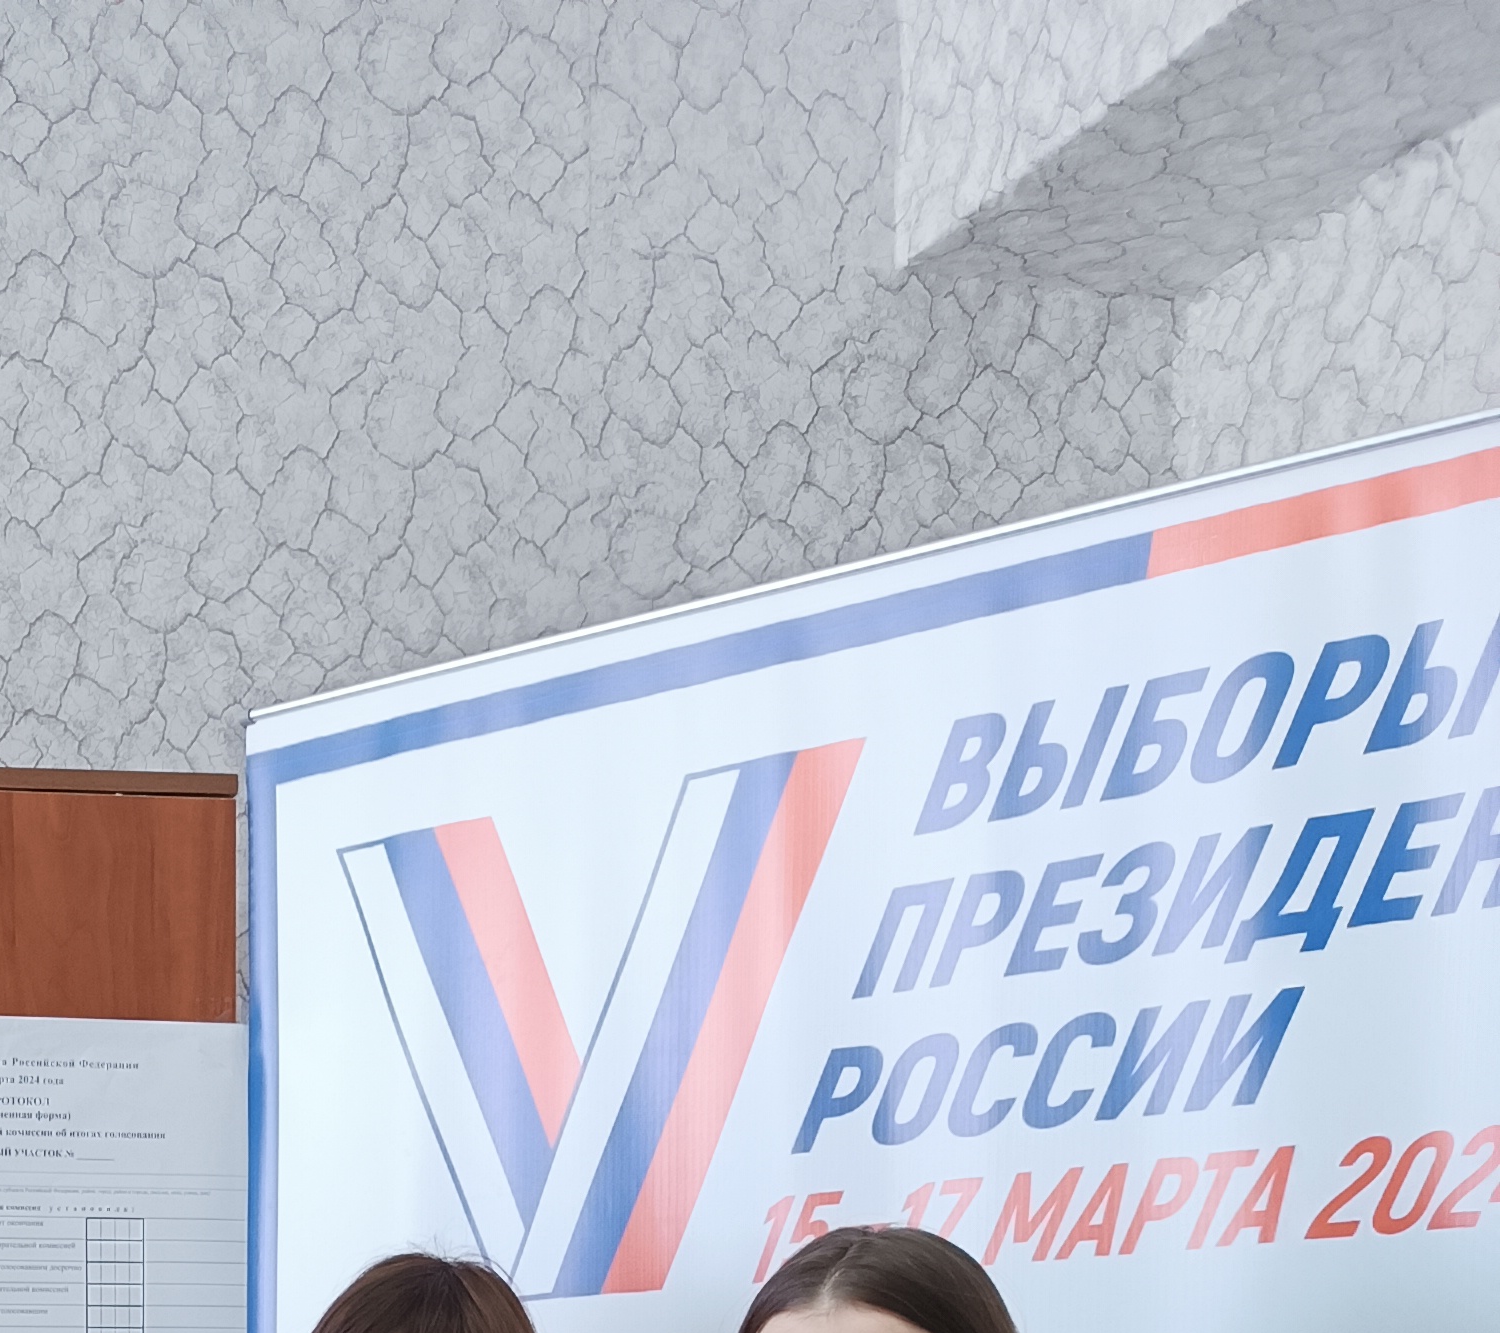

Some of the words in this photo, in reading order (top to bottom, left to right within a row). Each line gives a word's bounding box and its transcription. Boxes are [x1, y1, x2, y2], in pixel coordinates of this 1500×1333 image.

[913, 612, 1500, 836] ВЫБОРЫ
[790, 986, 1306, 1154] РОССИИ
[981, 1145, 1296, 1266] МАРТА
[1305, 1125, 1500, 1240] 202
